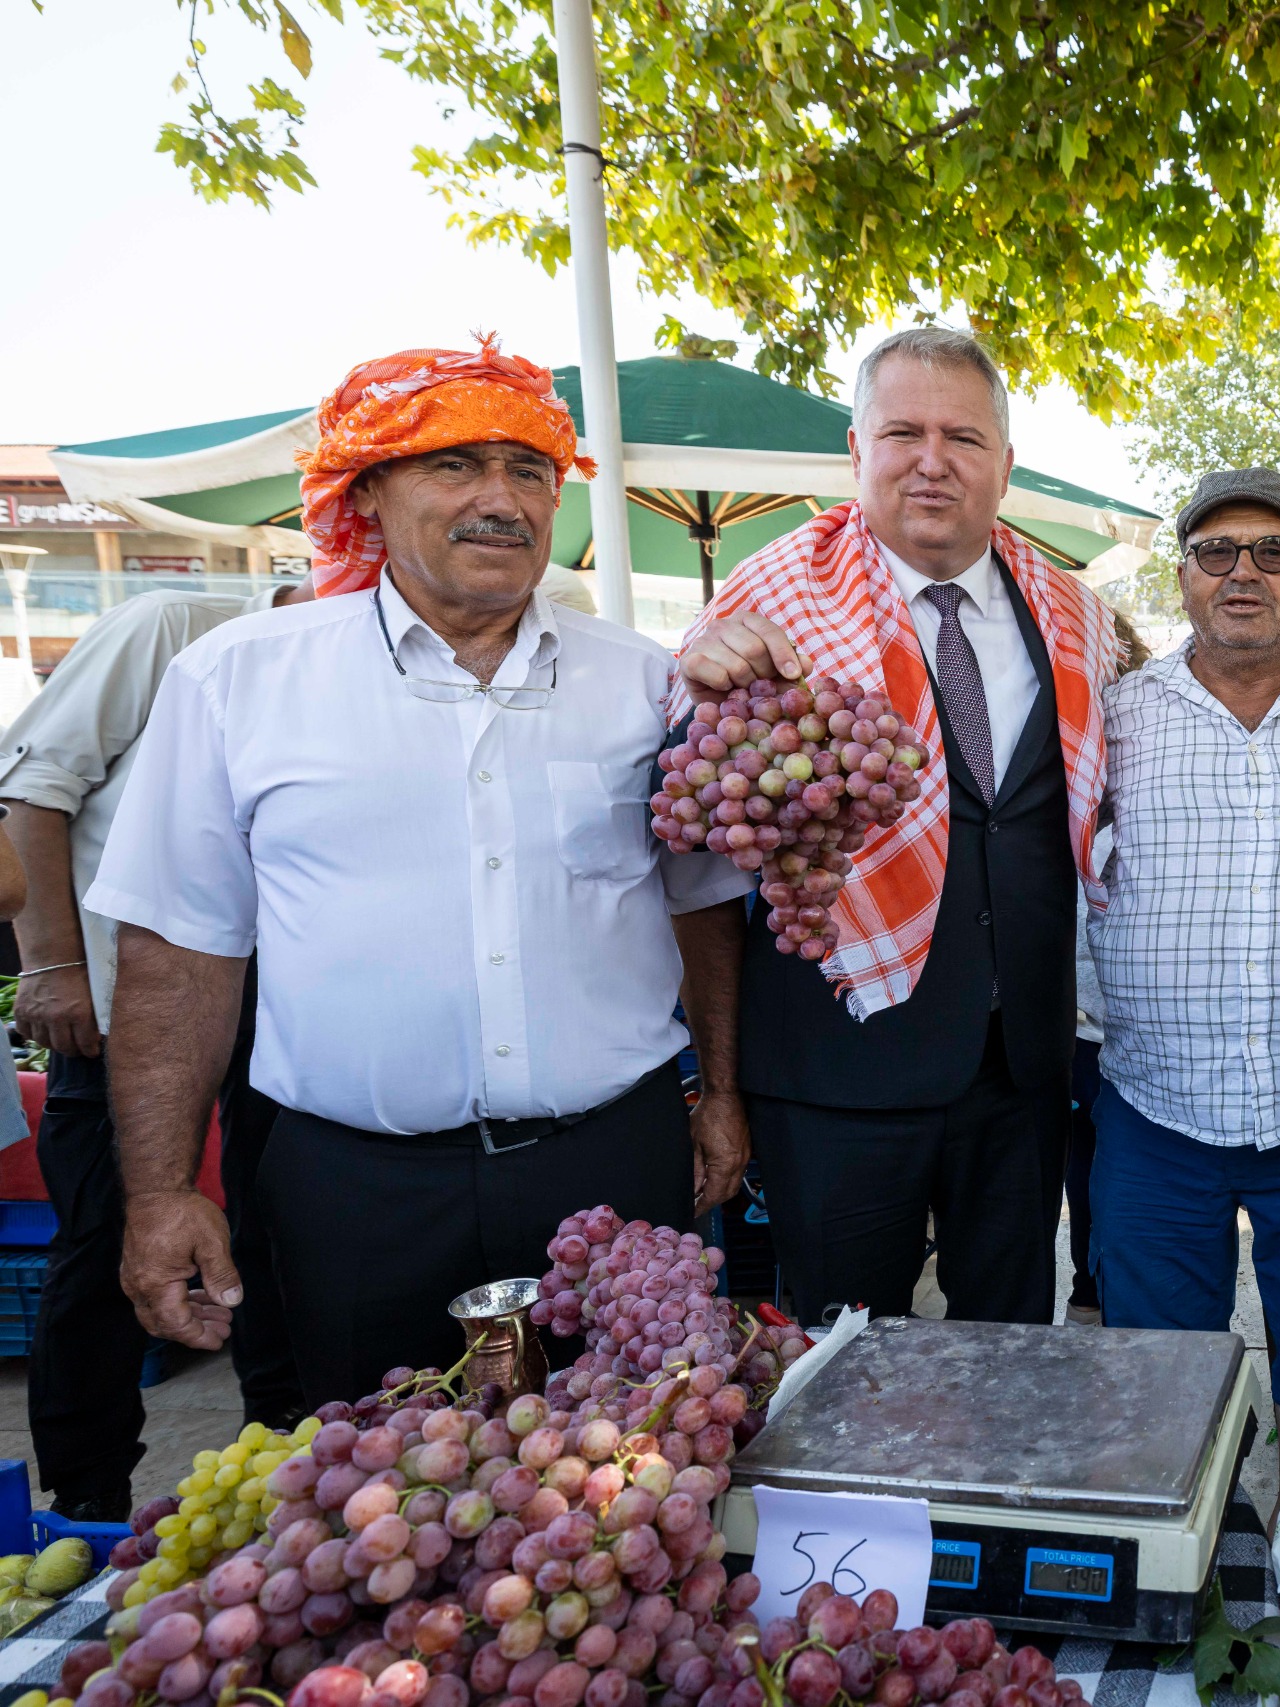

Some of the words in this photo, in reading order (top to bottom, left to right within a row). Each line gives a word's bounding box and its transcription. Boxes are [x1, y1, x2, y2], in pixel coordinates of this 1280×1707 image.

[935, 1542, 961, 1553] PRICE
[779, 1530, 868, 1597] 56
[1043, 1551, 1069, 1562] TOTAL
[1070, 1554, 1097, 1565] PRICE
